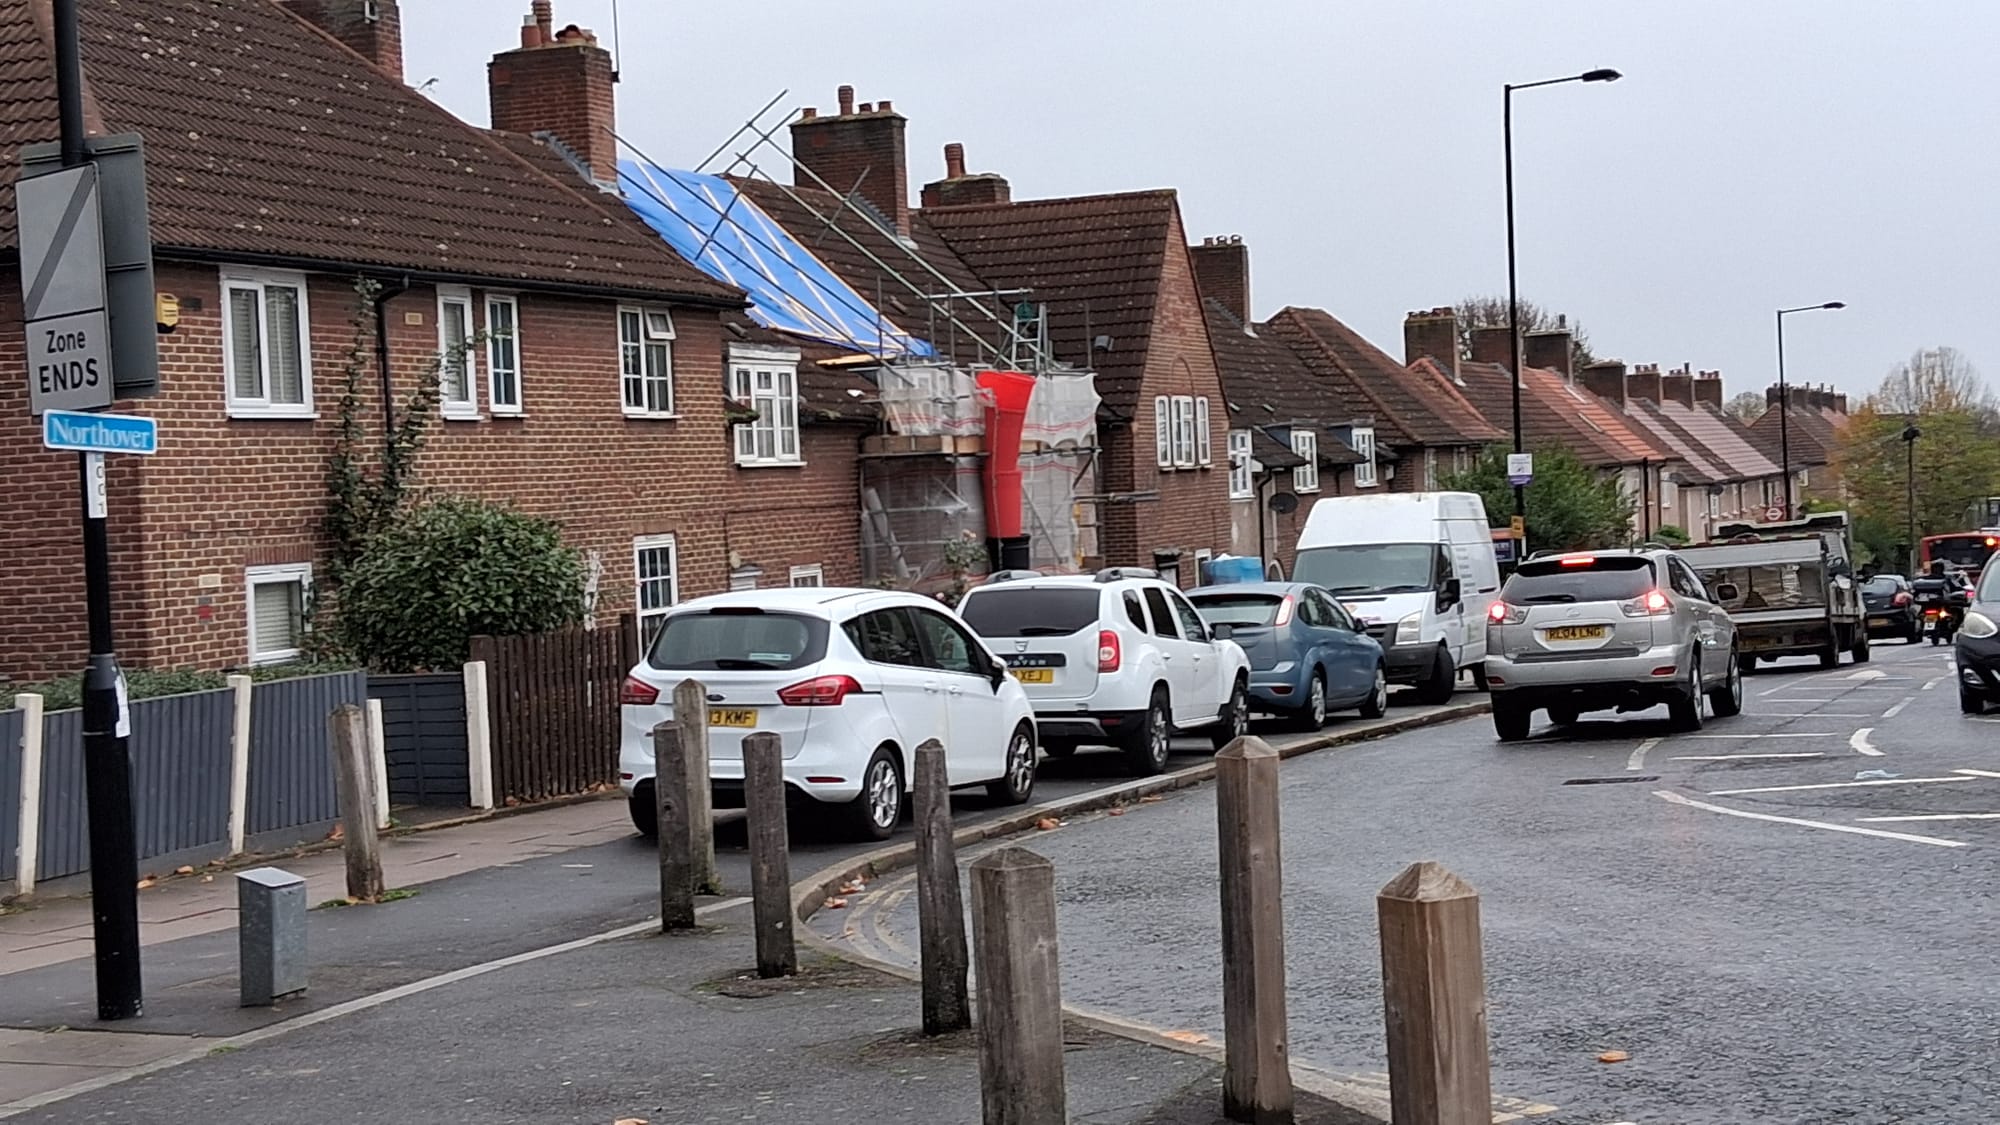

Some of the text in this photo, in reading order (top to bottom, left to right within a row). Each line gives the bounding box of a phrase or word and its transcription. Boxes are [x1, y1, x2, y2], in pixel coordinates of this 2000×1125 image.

[46, 330, 86, 353] Zone
[38, 358, 99, 394] ENDS
[51, 417, 150, 448] Northover
[725, 711, 753, 725] KMF
